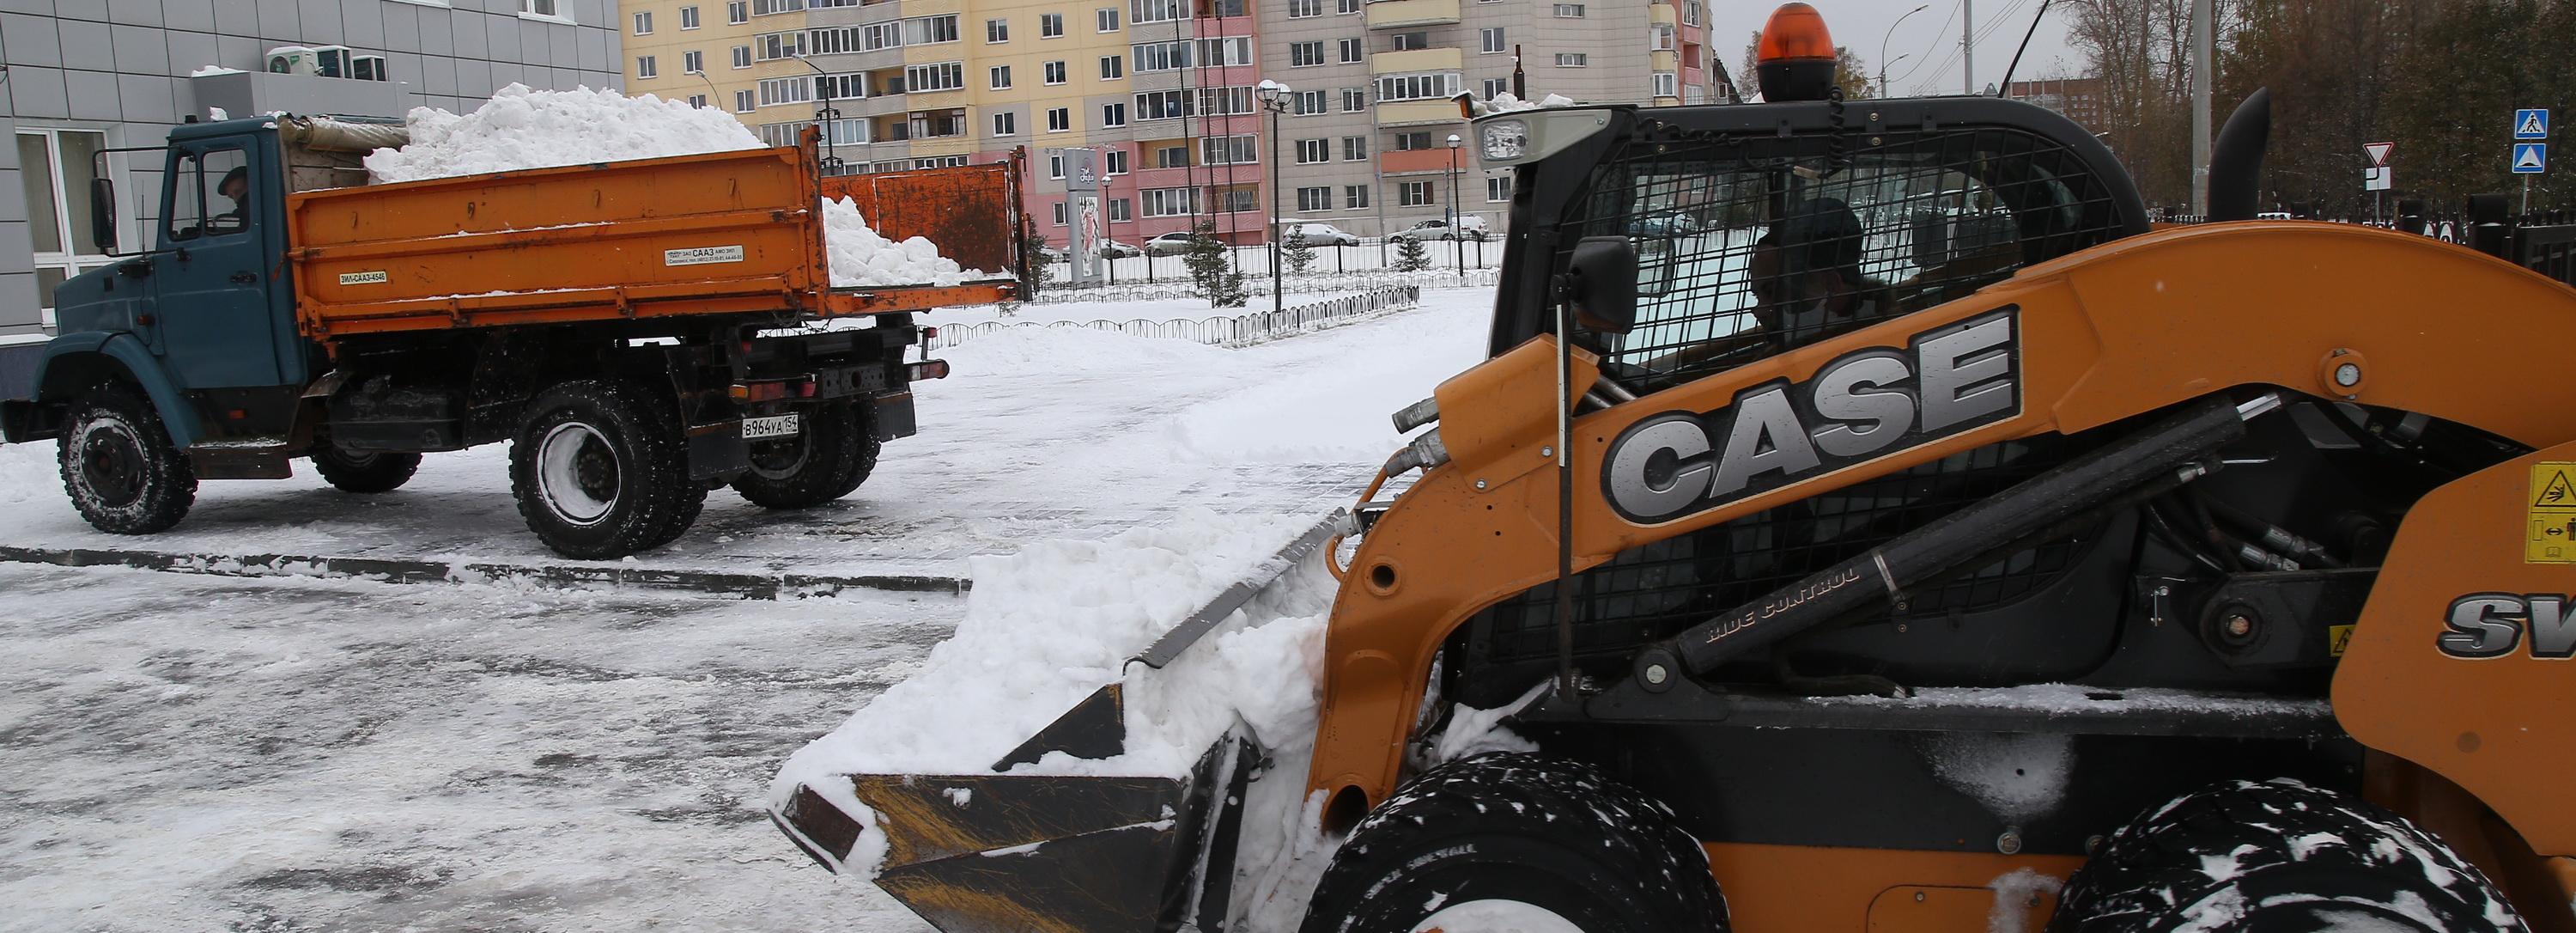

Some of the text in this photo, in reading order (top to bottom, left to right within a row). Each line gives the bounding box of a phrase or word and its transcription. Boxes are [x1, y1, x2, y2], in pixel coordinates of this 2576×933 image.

[692, 248, 714, 257] СААЗ
[783, 416, 797, 429] 154
[1610, 315, 2013, 516] CASE
[1704, 568, 1860, 643] RIDE CONTROL
